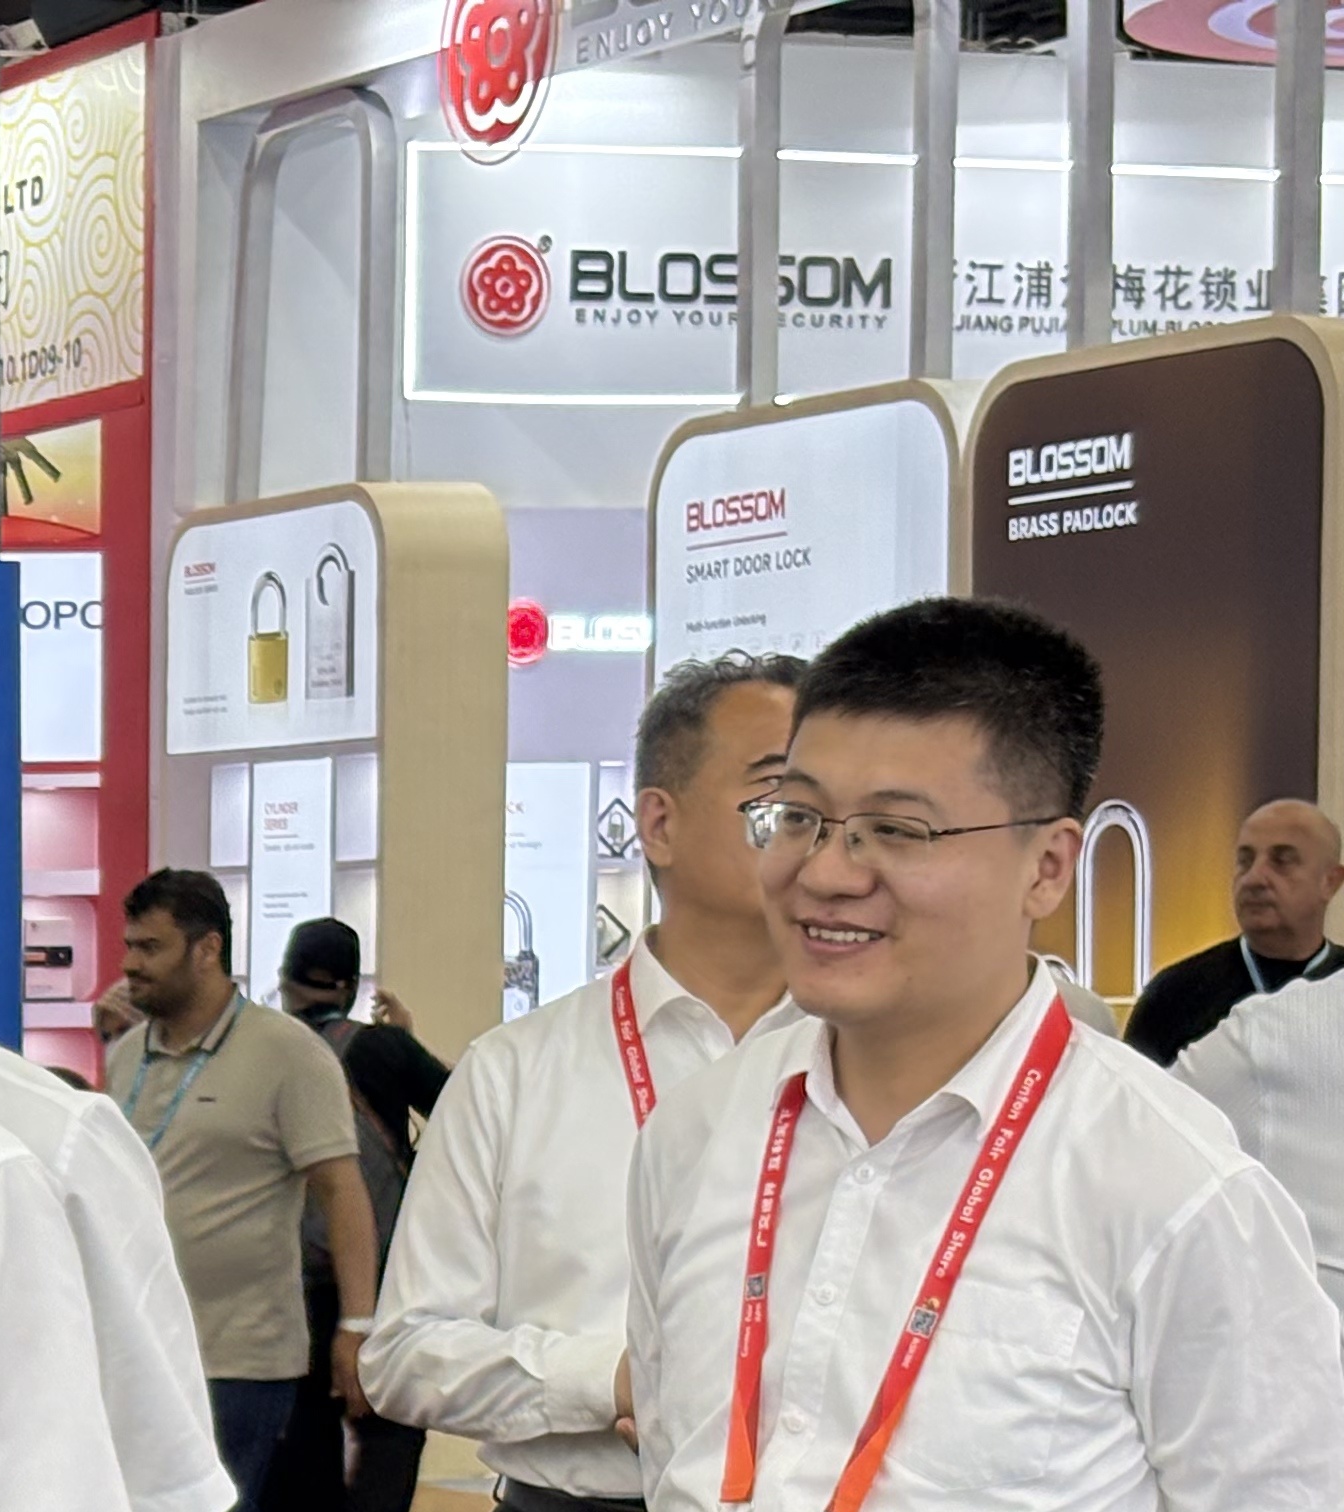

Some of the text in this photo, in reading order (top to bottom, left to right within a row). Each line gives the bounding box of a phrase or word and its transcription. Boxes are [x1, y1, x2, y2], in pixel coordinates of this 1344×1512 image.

[575, 11, 673, 64] ENJOY
[691, 0, 748, 31] YOU
[3, 175, 44, 214] LTD
[575, 308, 659, 326] ENJOY
[778, 311, 889, 331] ECURITY
[953, 315, 1014, 334] JIANG
[1008, 431, 1132, 487] BLOSSOM
[686, 487, 786, 533] BLOSSOM
[1008, 501, 1138, 541] BRASS PADLOCK
[686, 546, 812, 585] SMART DOOR LOCK
[936, 1068, 1042, 1279] Canton Fair Global Share
